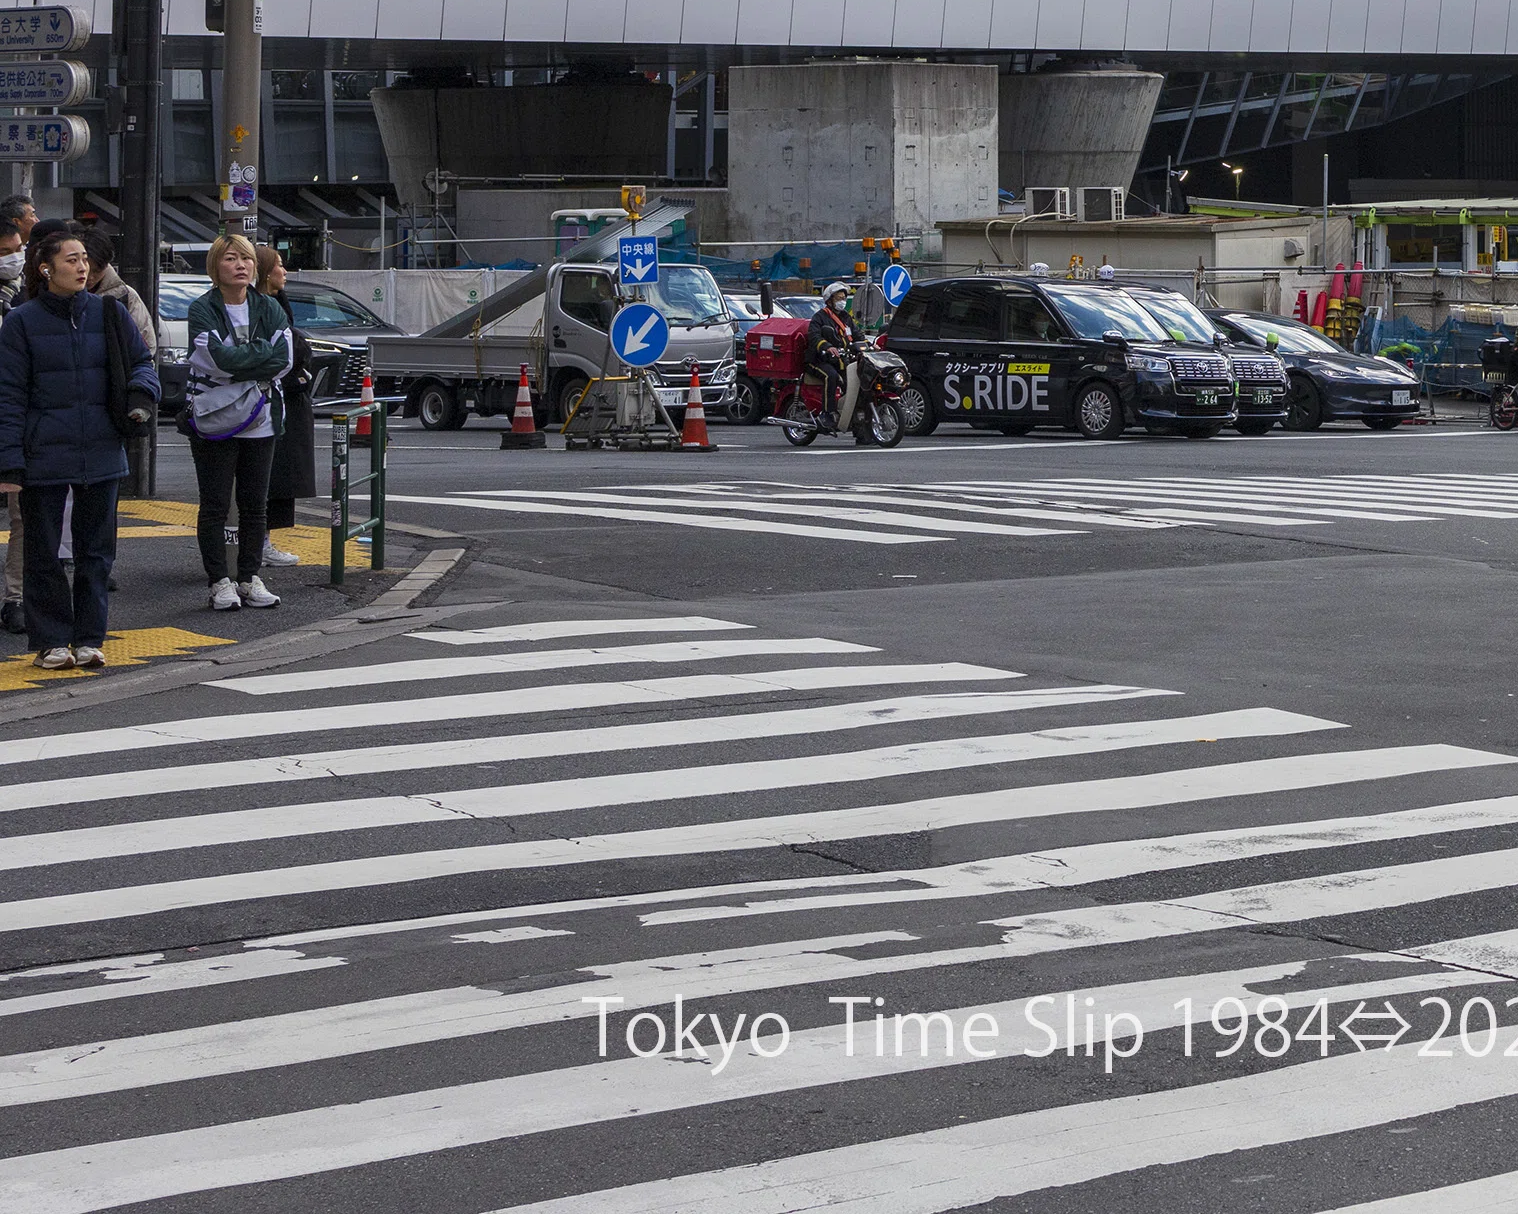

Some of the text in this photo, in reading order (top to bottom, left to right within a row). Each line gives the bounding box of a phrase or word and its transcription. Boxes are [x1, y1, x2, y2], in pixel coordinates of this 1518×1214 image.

[621, 243, 655, 257] 中央線
[945, 362, 1005, 373] タクシーアプリ
[943, 374, 1050, 411] S.RIDE
